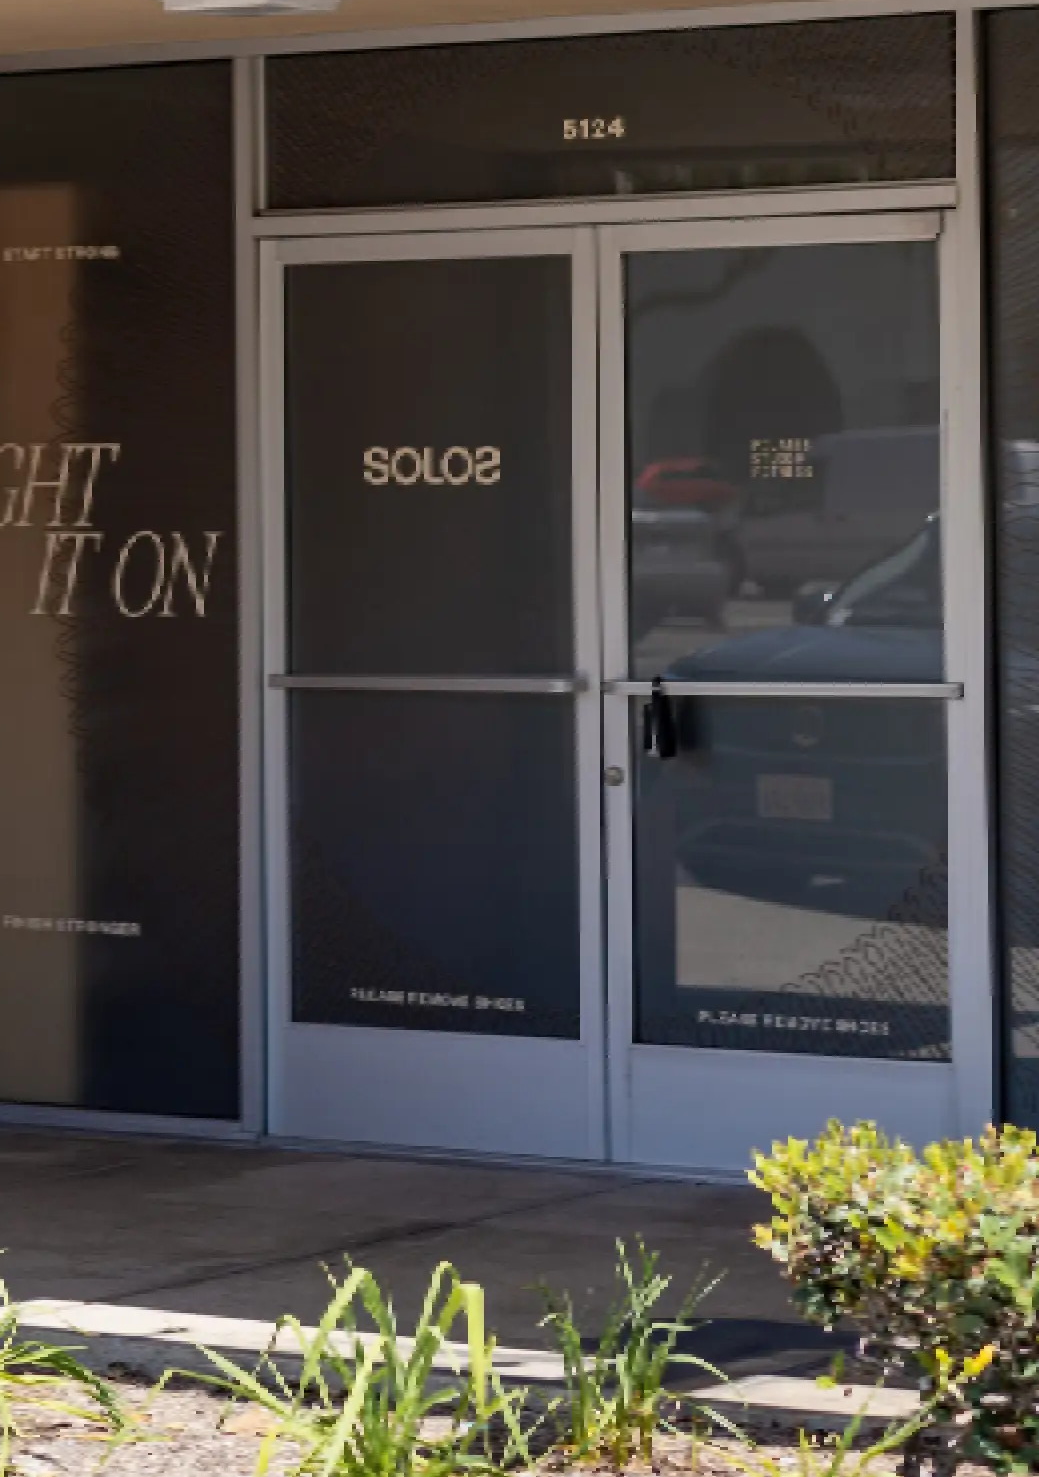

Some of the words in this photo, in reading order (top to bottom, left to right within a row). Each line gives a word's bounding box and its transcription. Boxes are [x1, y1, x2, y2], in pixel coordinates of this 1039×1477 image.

[563, 116, 625, 139] 5124
[363, 445, 501, 486] SOLOS
[29, 530, 105, 615] IT
[113, 530, 225, 617] ON
